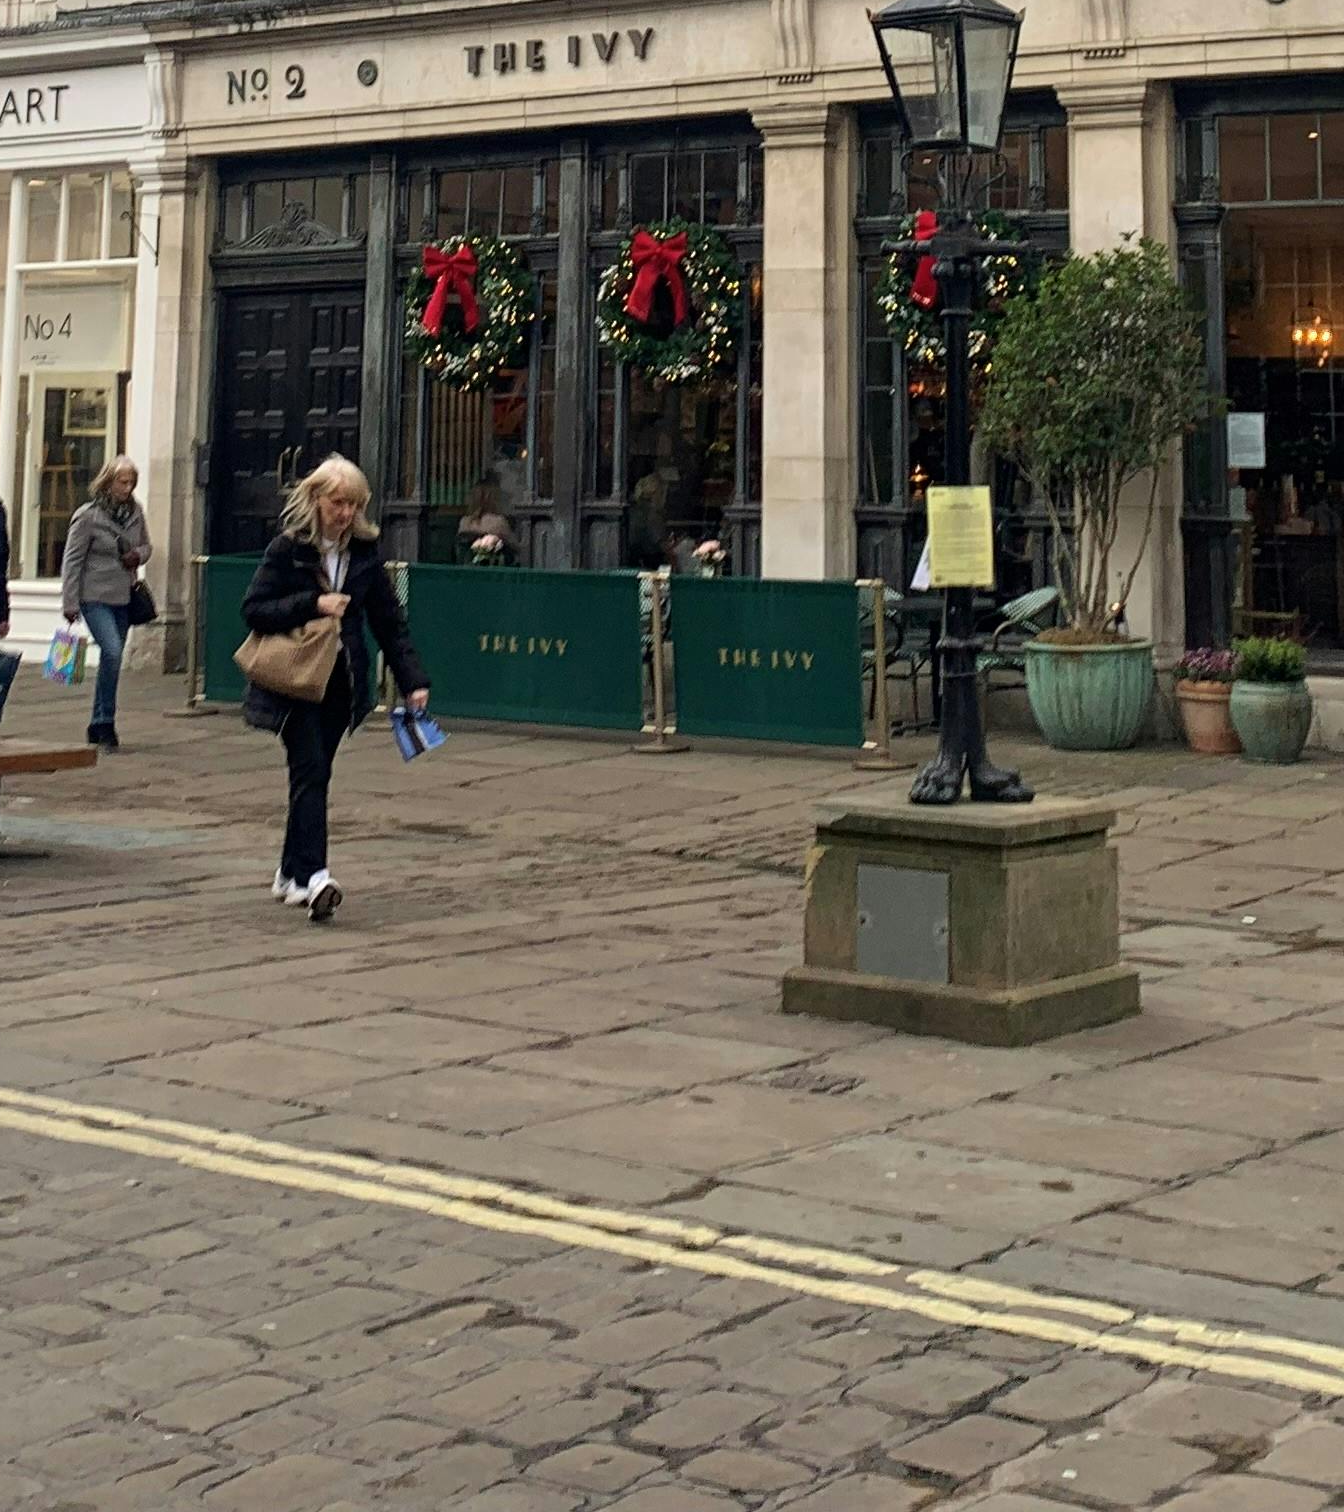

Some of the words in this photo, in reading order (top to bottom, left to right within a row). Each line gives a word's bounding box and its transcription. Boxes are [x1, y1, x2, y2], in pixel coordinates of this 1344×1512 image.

[462, 38, 546, 79] THE
[567, 27, 655, 69] IVY
[284, 64, 308, 100] 2
[23, 313, 55, 341] No
[58, 312, 72, 339] 4
[478, 633, 520, 654] THE
[527, 636, 569, 656] IVY
[718, 647, 761, 667] THE
[771, 649, 815, 671] IVY
